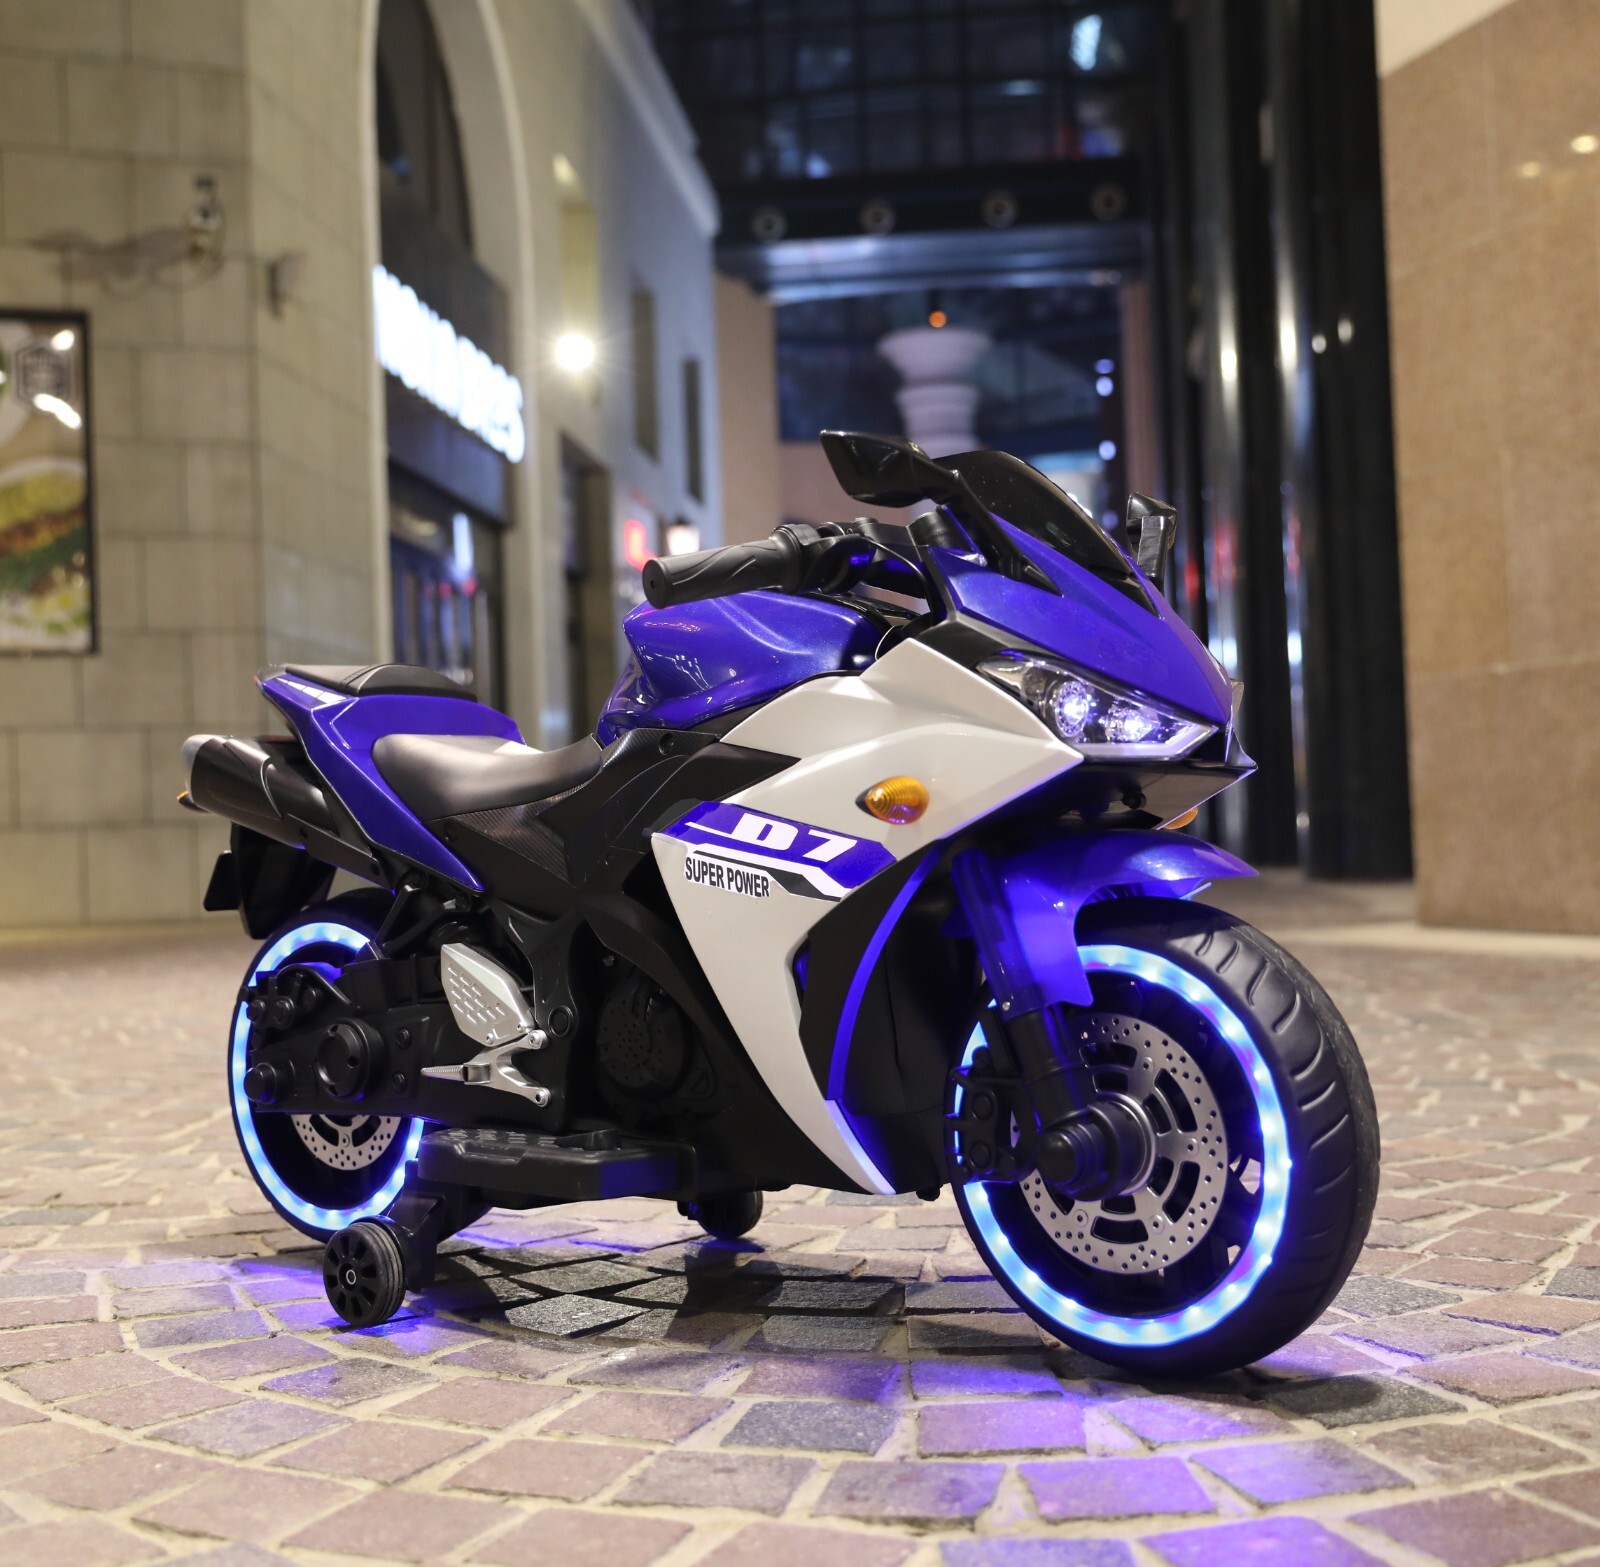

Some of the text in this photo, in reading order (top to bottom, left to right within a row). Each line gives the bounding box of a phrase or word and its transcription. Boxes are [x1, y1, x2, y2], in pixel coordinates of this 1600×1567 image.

[730, 812, 858, 863] D7
[684, 856, 770, 897] SUPER POWER
